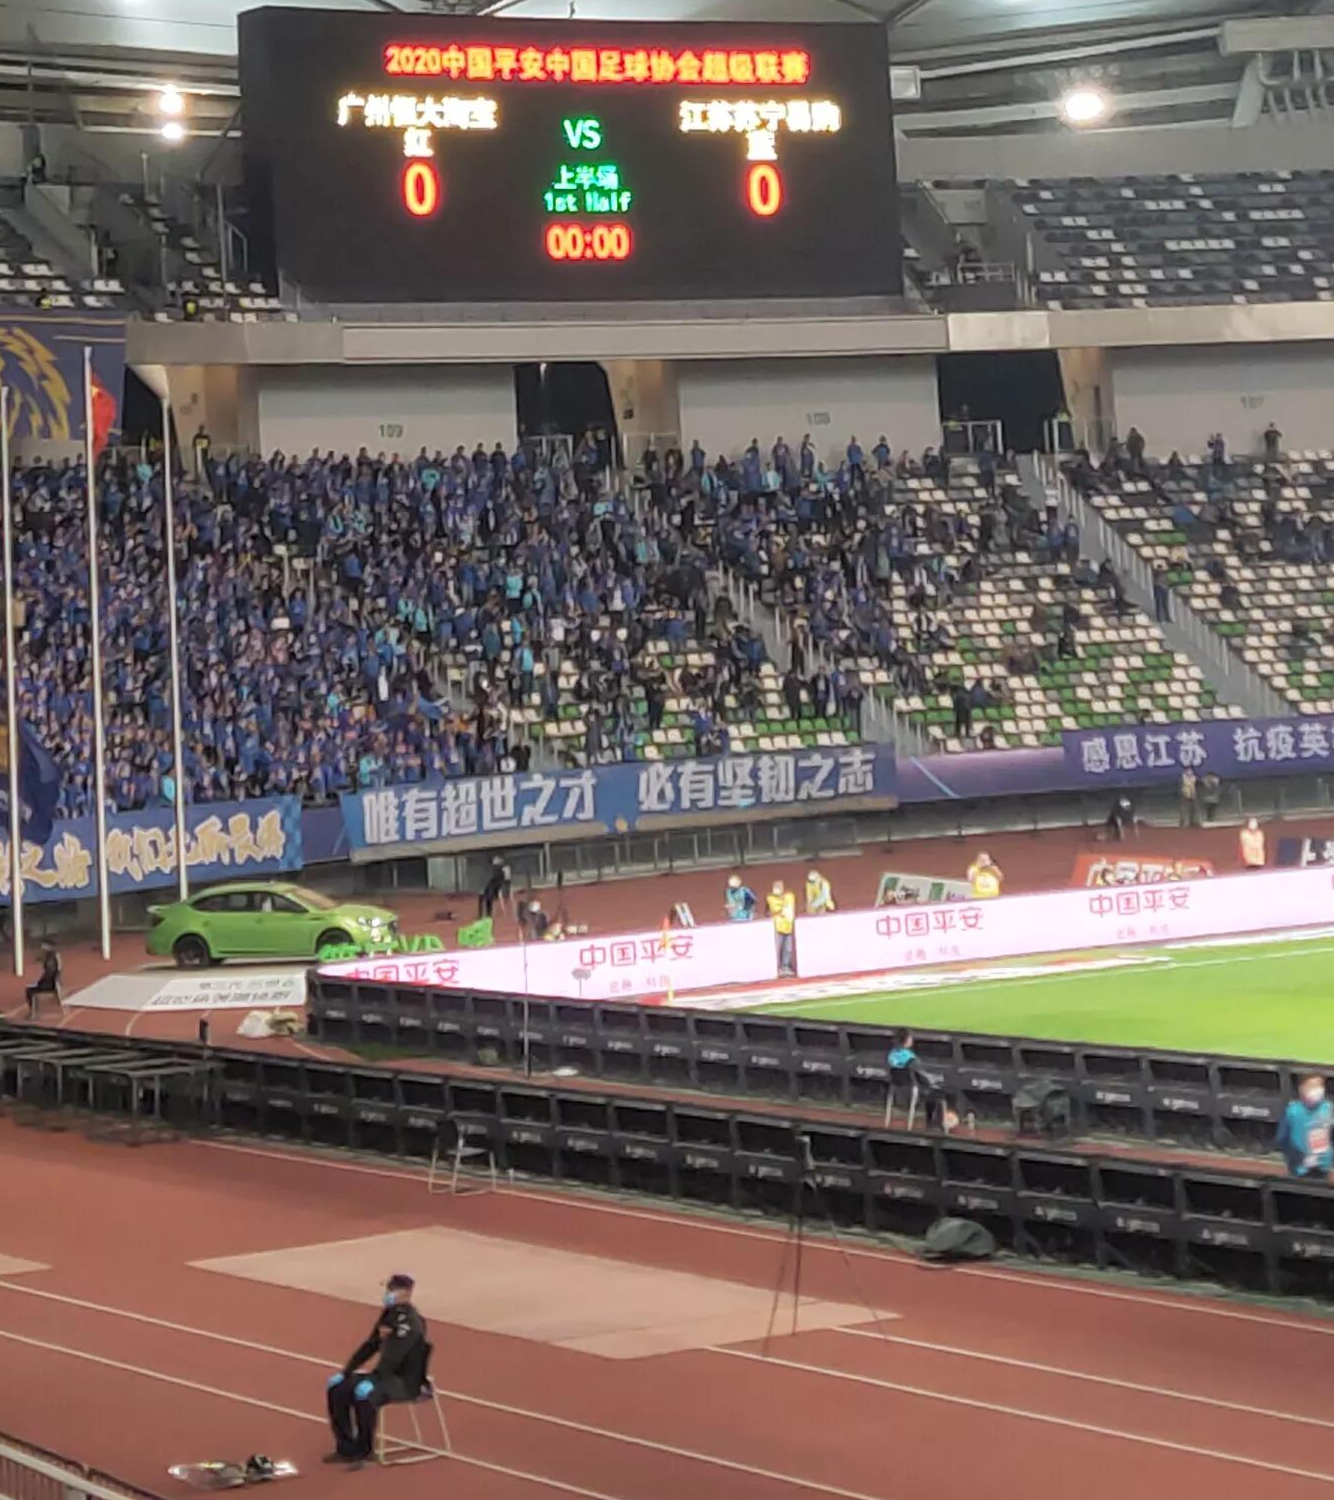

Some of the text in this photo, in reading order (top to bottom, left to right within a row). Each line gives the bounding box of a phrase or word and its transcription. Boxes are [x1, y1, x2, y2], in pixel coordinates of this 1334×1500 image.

[384, 43, 809, 82] 2020中国平安中国足球协会超级联赛
[563, 119, 601, 149] VS
[405, 163, 436, 216] 0
[553, 165, 619, 190] 上半场
[750, 164, 781, 216] 0
[544, 191, 632, 212] 1st Half
[546, 225, 631, 260] 00:00
[1081, 730, 1207, 773] 感恩江苏
[1089, 887, 1190, 917] 中国平安
[875, 906, 984, 939] 中国平安
[579, 935, 693, 970] 中国平安
